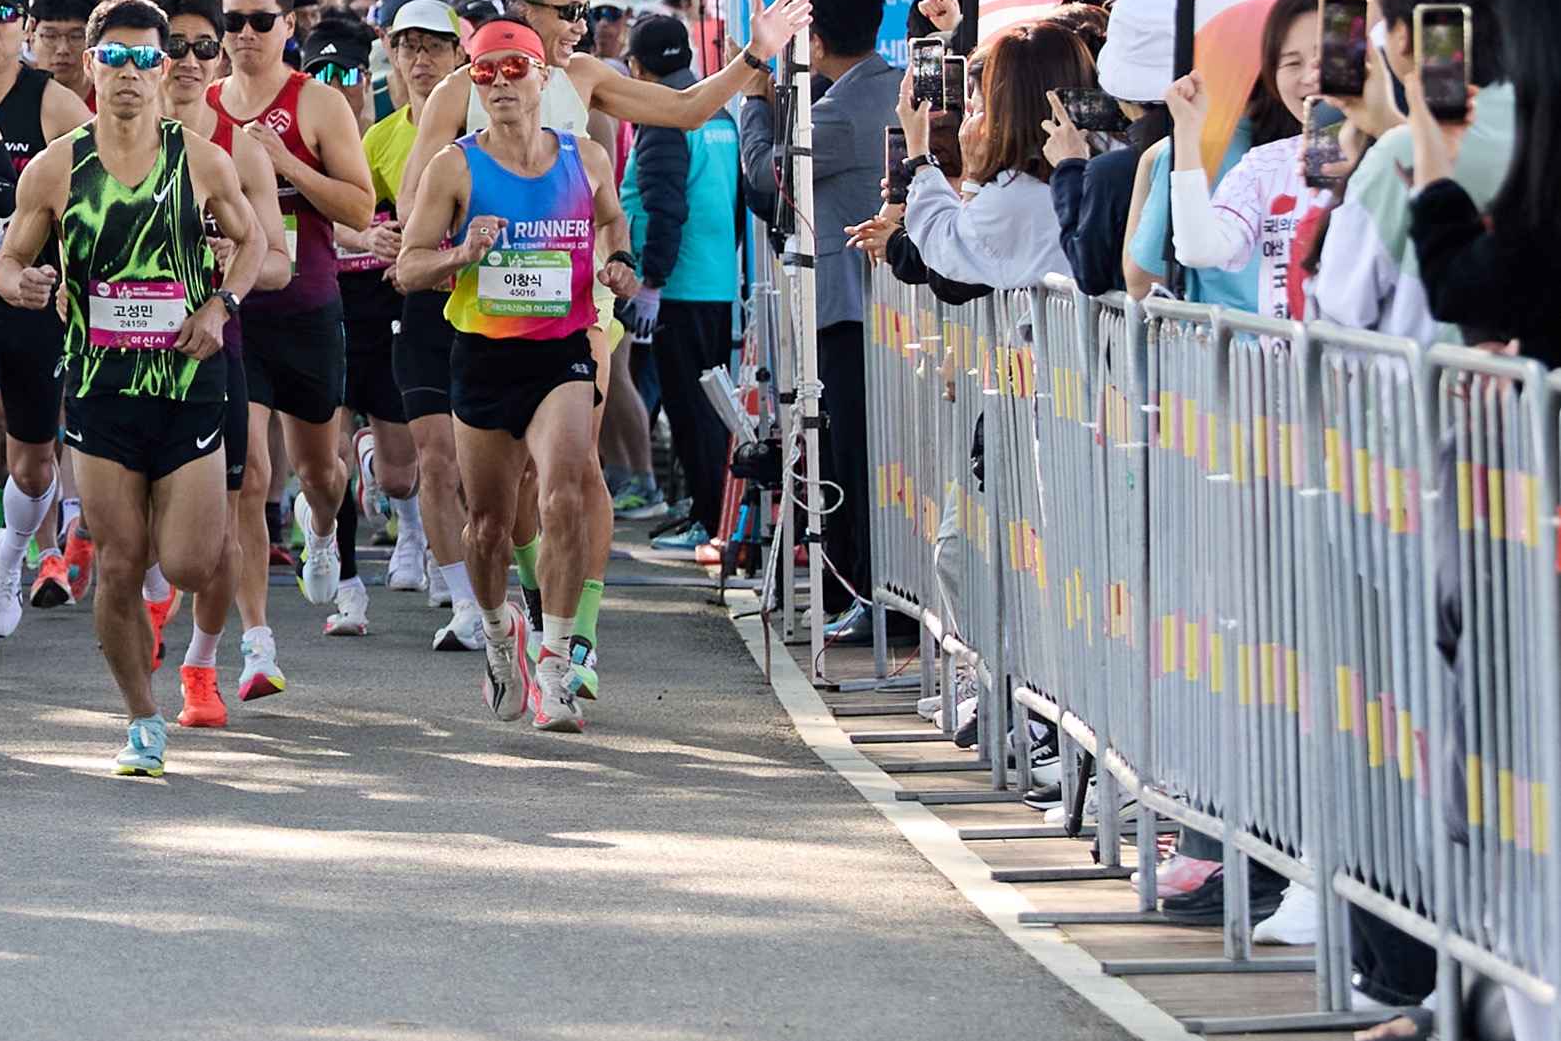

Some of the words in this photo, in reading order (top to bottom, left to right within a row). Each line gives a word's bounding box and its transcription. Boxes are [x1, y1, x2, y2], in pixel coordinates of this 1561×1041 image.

[504, 273, 542, 288] 이창식
[113, 304, 153, 319] 고성민
[131, 336, 166, 347] 아산시
